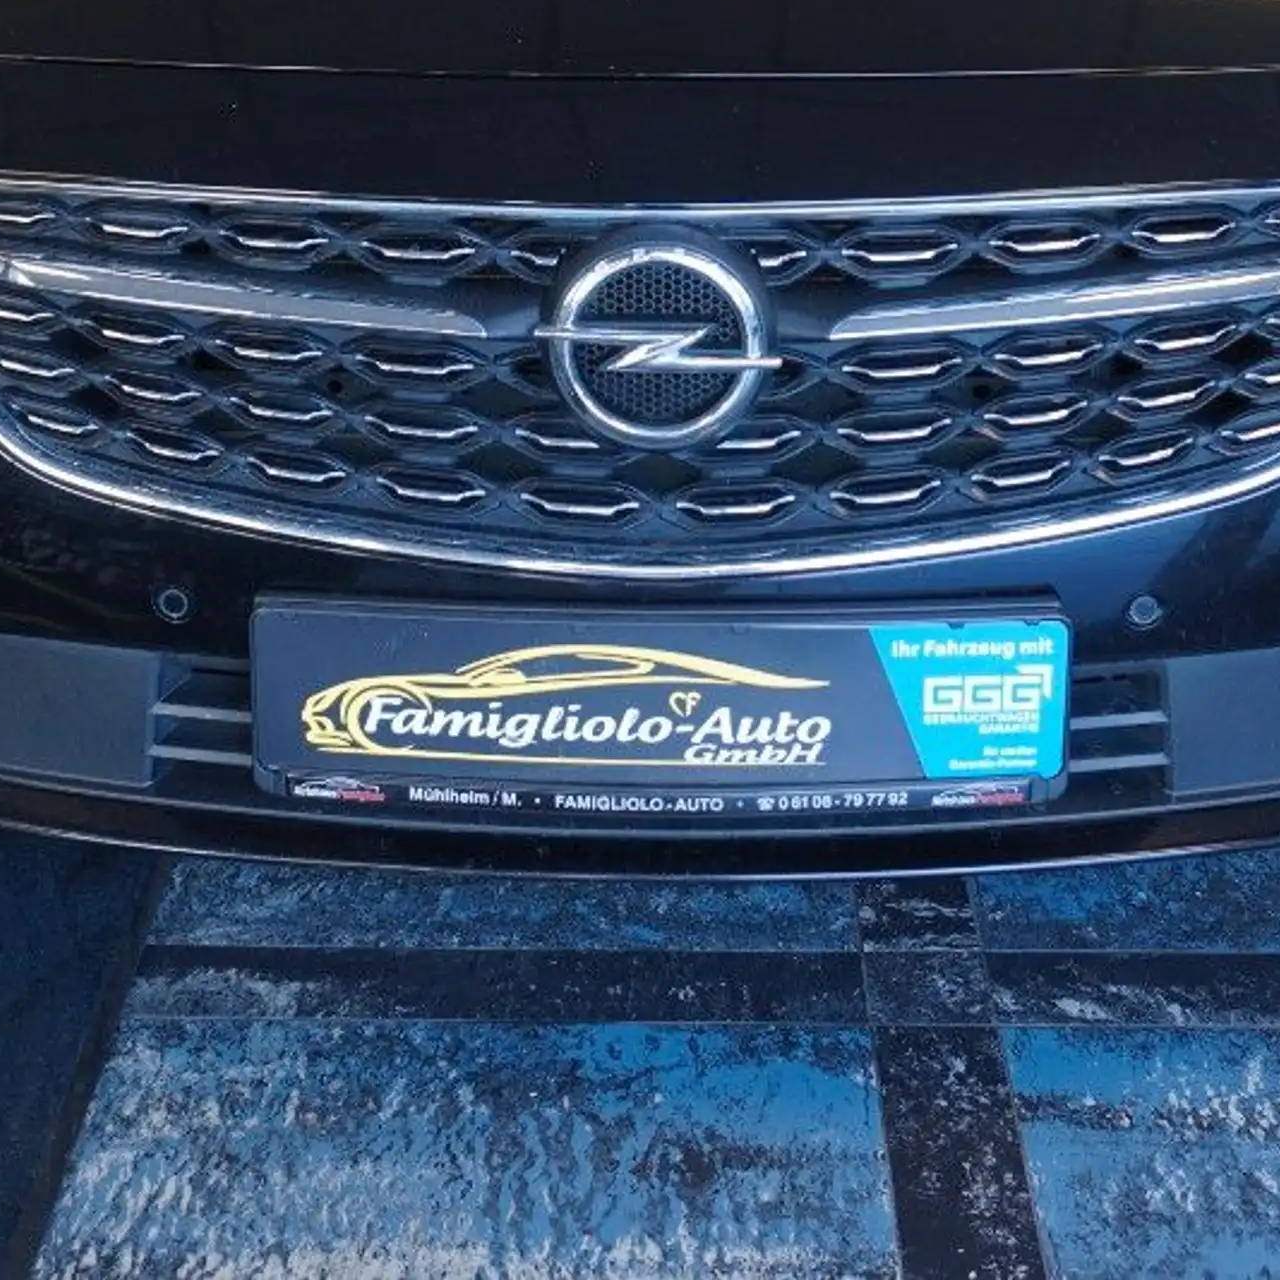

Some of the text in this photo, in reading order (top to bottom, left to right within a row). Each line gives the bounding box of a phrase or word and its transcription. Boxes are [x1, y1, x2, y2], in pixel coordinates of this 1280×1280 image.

[890, 636, 1054, 660] Ihr Fahrzeug mit
[923, 674, 1041, 713] GGG
[363, 694, 832, 748] Famigliolo-Auto
[683, 742, 825, 765] GmbH
